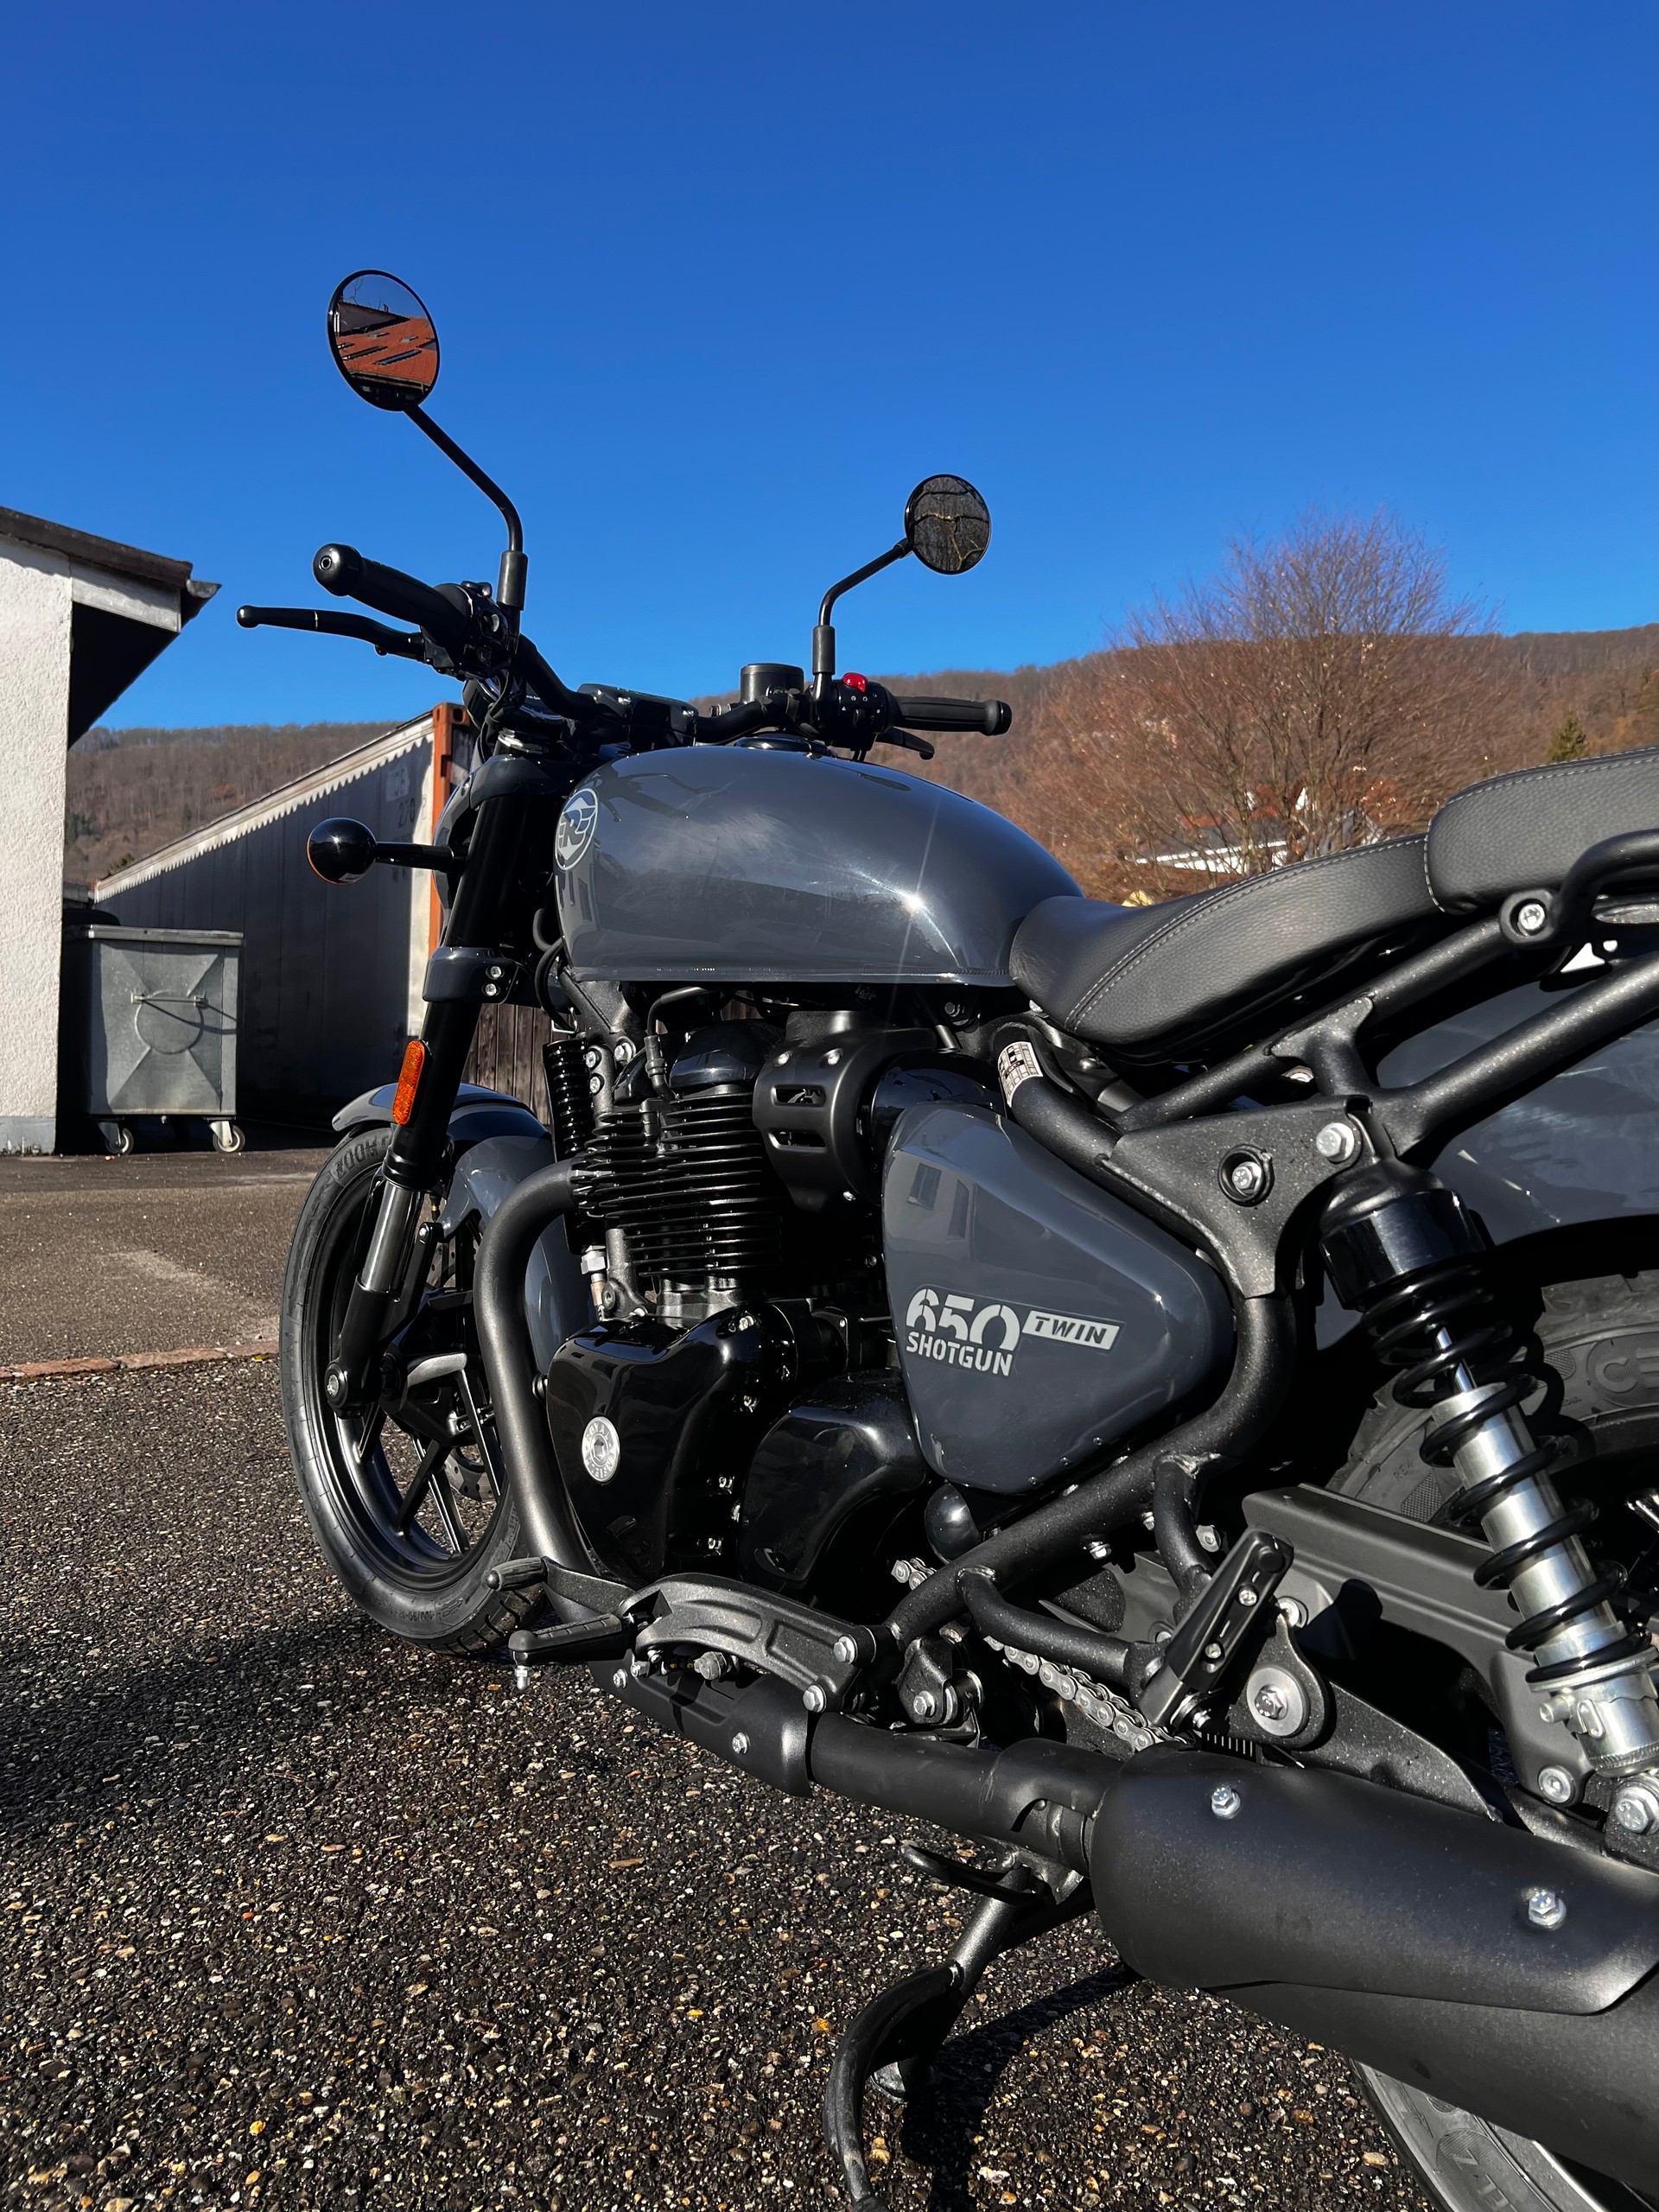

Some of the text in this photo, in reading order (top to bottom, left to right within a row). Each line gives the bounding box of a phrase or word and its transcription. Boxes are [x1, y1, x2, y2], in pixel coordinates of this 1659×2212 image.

[906, 1288, 1108, 1351] 650 TWIN
[906, 1332, 1013, 1376] SHOTGUN
